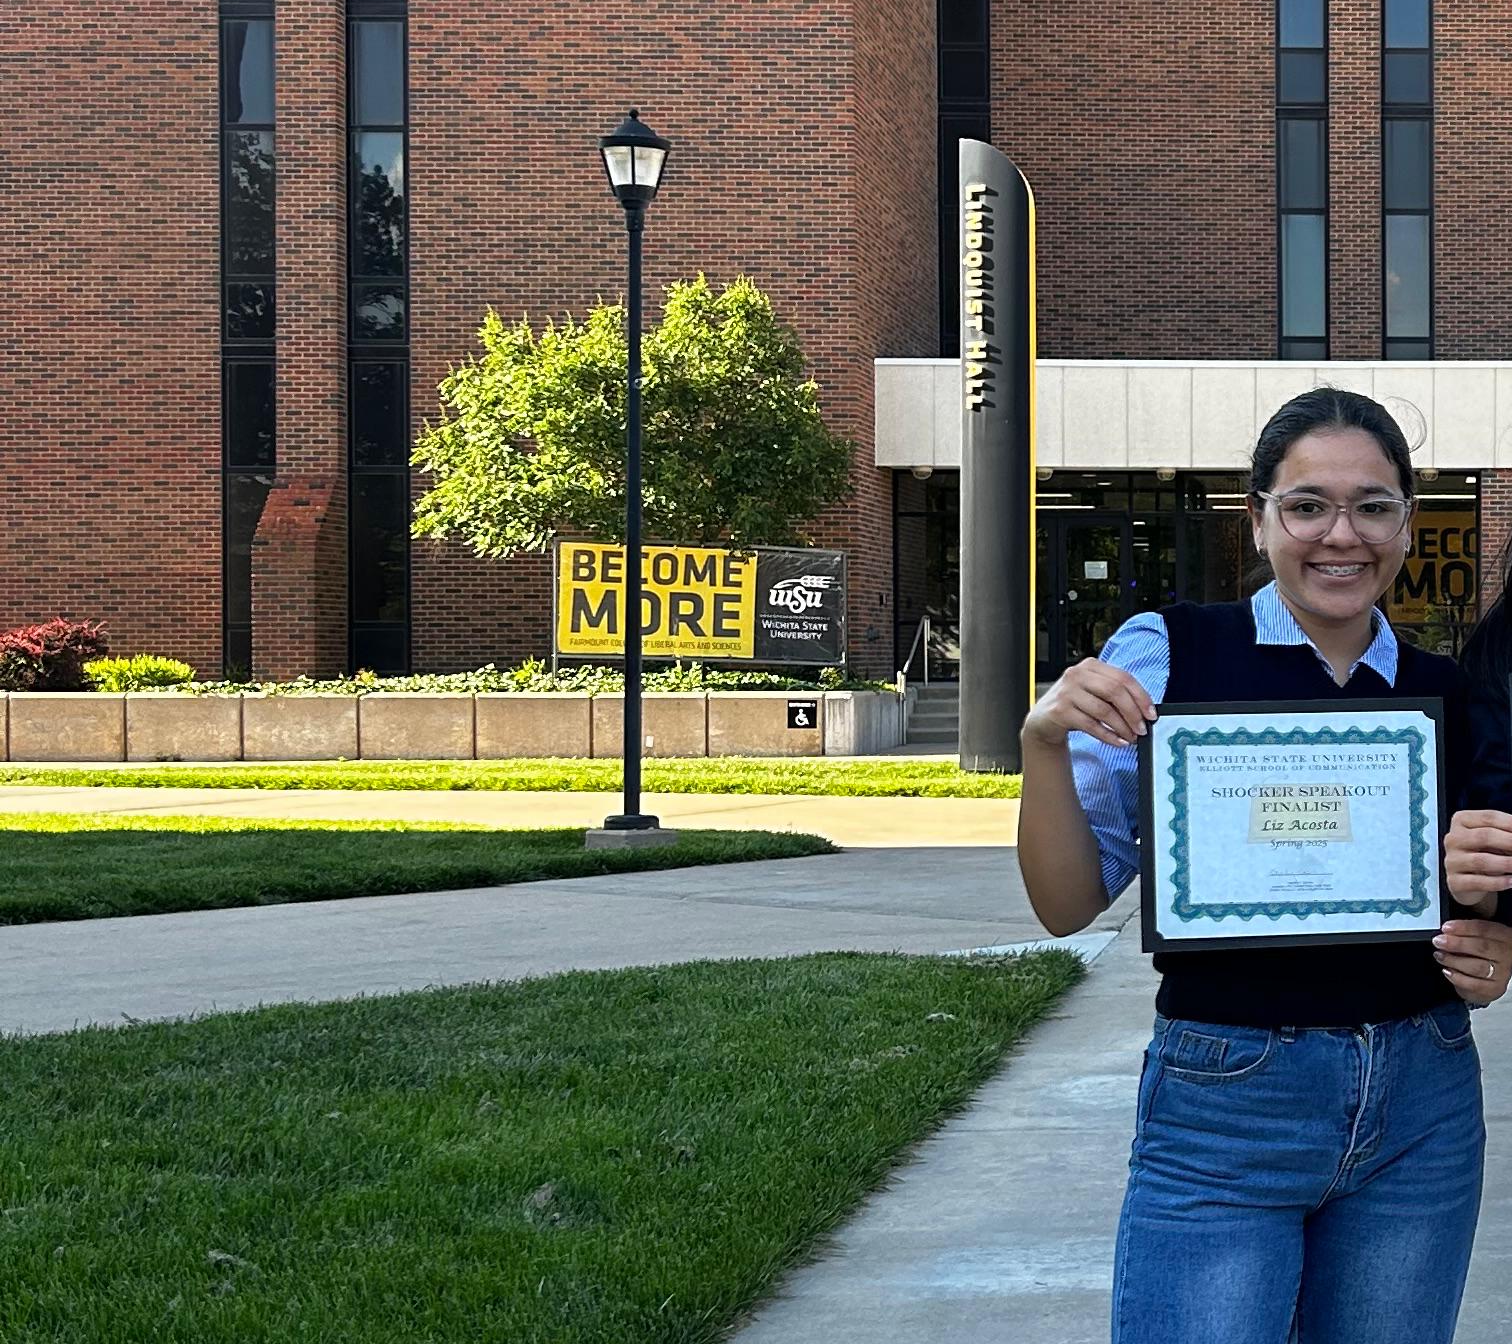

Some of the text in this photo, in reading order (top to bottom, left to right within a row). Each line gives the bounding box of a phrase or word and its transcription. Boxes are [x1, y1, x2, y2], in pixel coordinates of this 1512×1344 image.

[963, 183, 988, 410] LINDQUIST HALL
[761, 619, 829, 631] WICHITA STATE
[770, 629, 823, 640] UNIVERSITY
[1196, 753, 1398, 764] WICHITA STATE UNIVERSITY
[1211, 785, 1391, 798] SHOCKER SPEAKOUT
[1262, 801, 1342, 812] FINALIST
[1261, 819, 1339, 831] Liz Acosta
[1270, 839, 1303, 850] Spring
